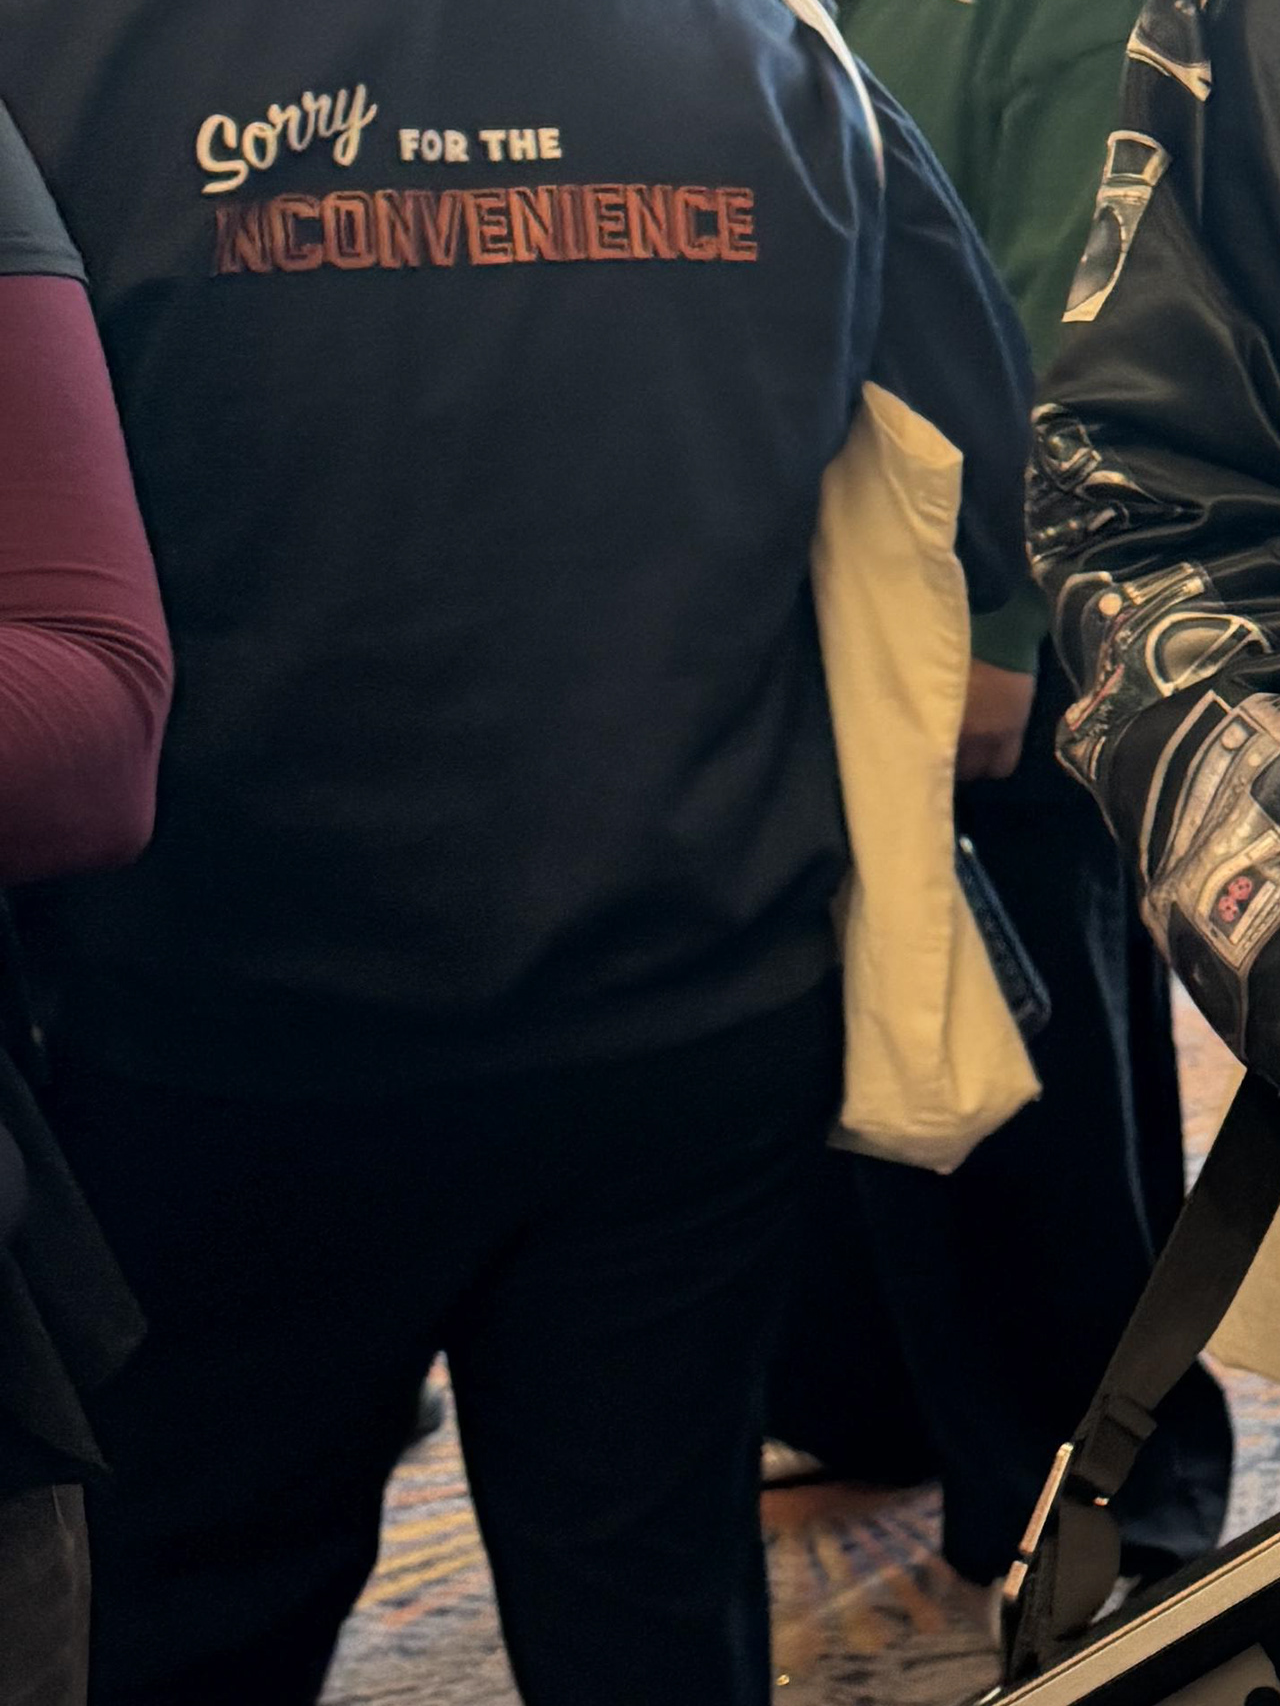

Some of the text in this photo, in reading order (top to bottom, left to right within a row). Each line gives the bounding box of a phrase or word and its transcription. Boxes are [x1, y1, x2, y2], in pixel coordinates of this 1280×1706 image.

[197, 84, 562, 193] Sorry FOR THE
